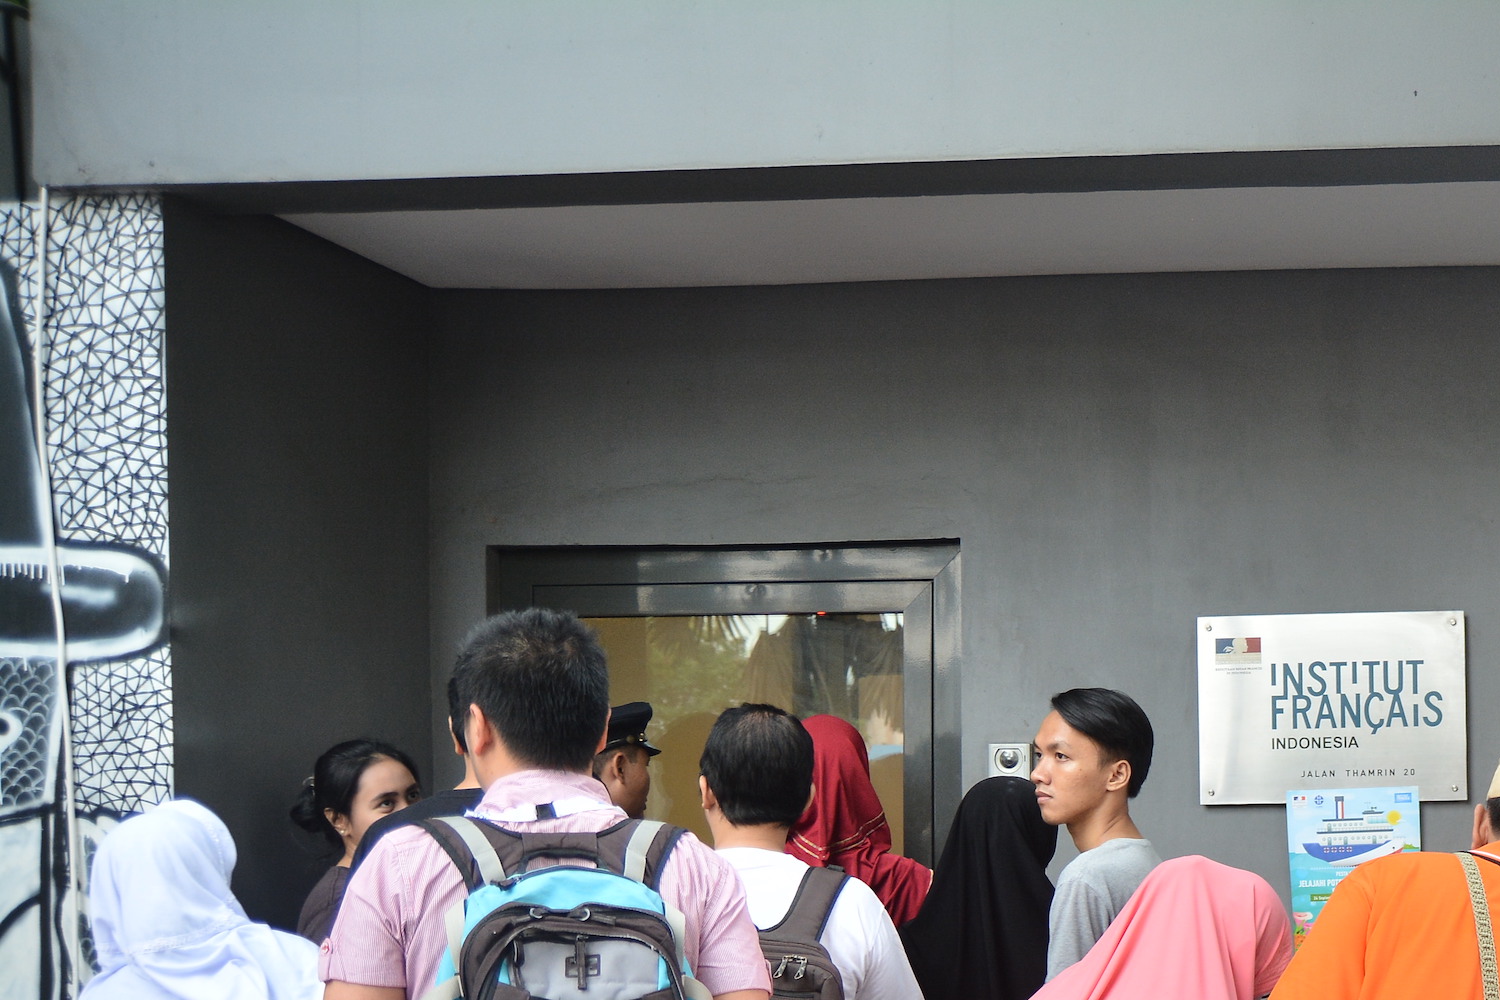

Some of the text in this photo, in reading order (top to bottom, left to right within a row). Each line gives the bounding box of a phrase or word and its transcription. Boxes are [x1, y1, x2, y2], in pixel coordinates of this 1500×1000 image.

[1270, 660, 1425, 697] INSTITUT
[1271, 736, 1359, 750] INDONESIA
[1301, 768, 1416, 778] JALAN THAMRIN 20
[1299, 880, 1326, 888] JELAJAHI
